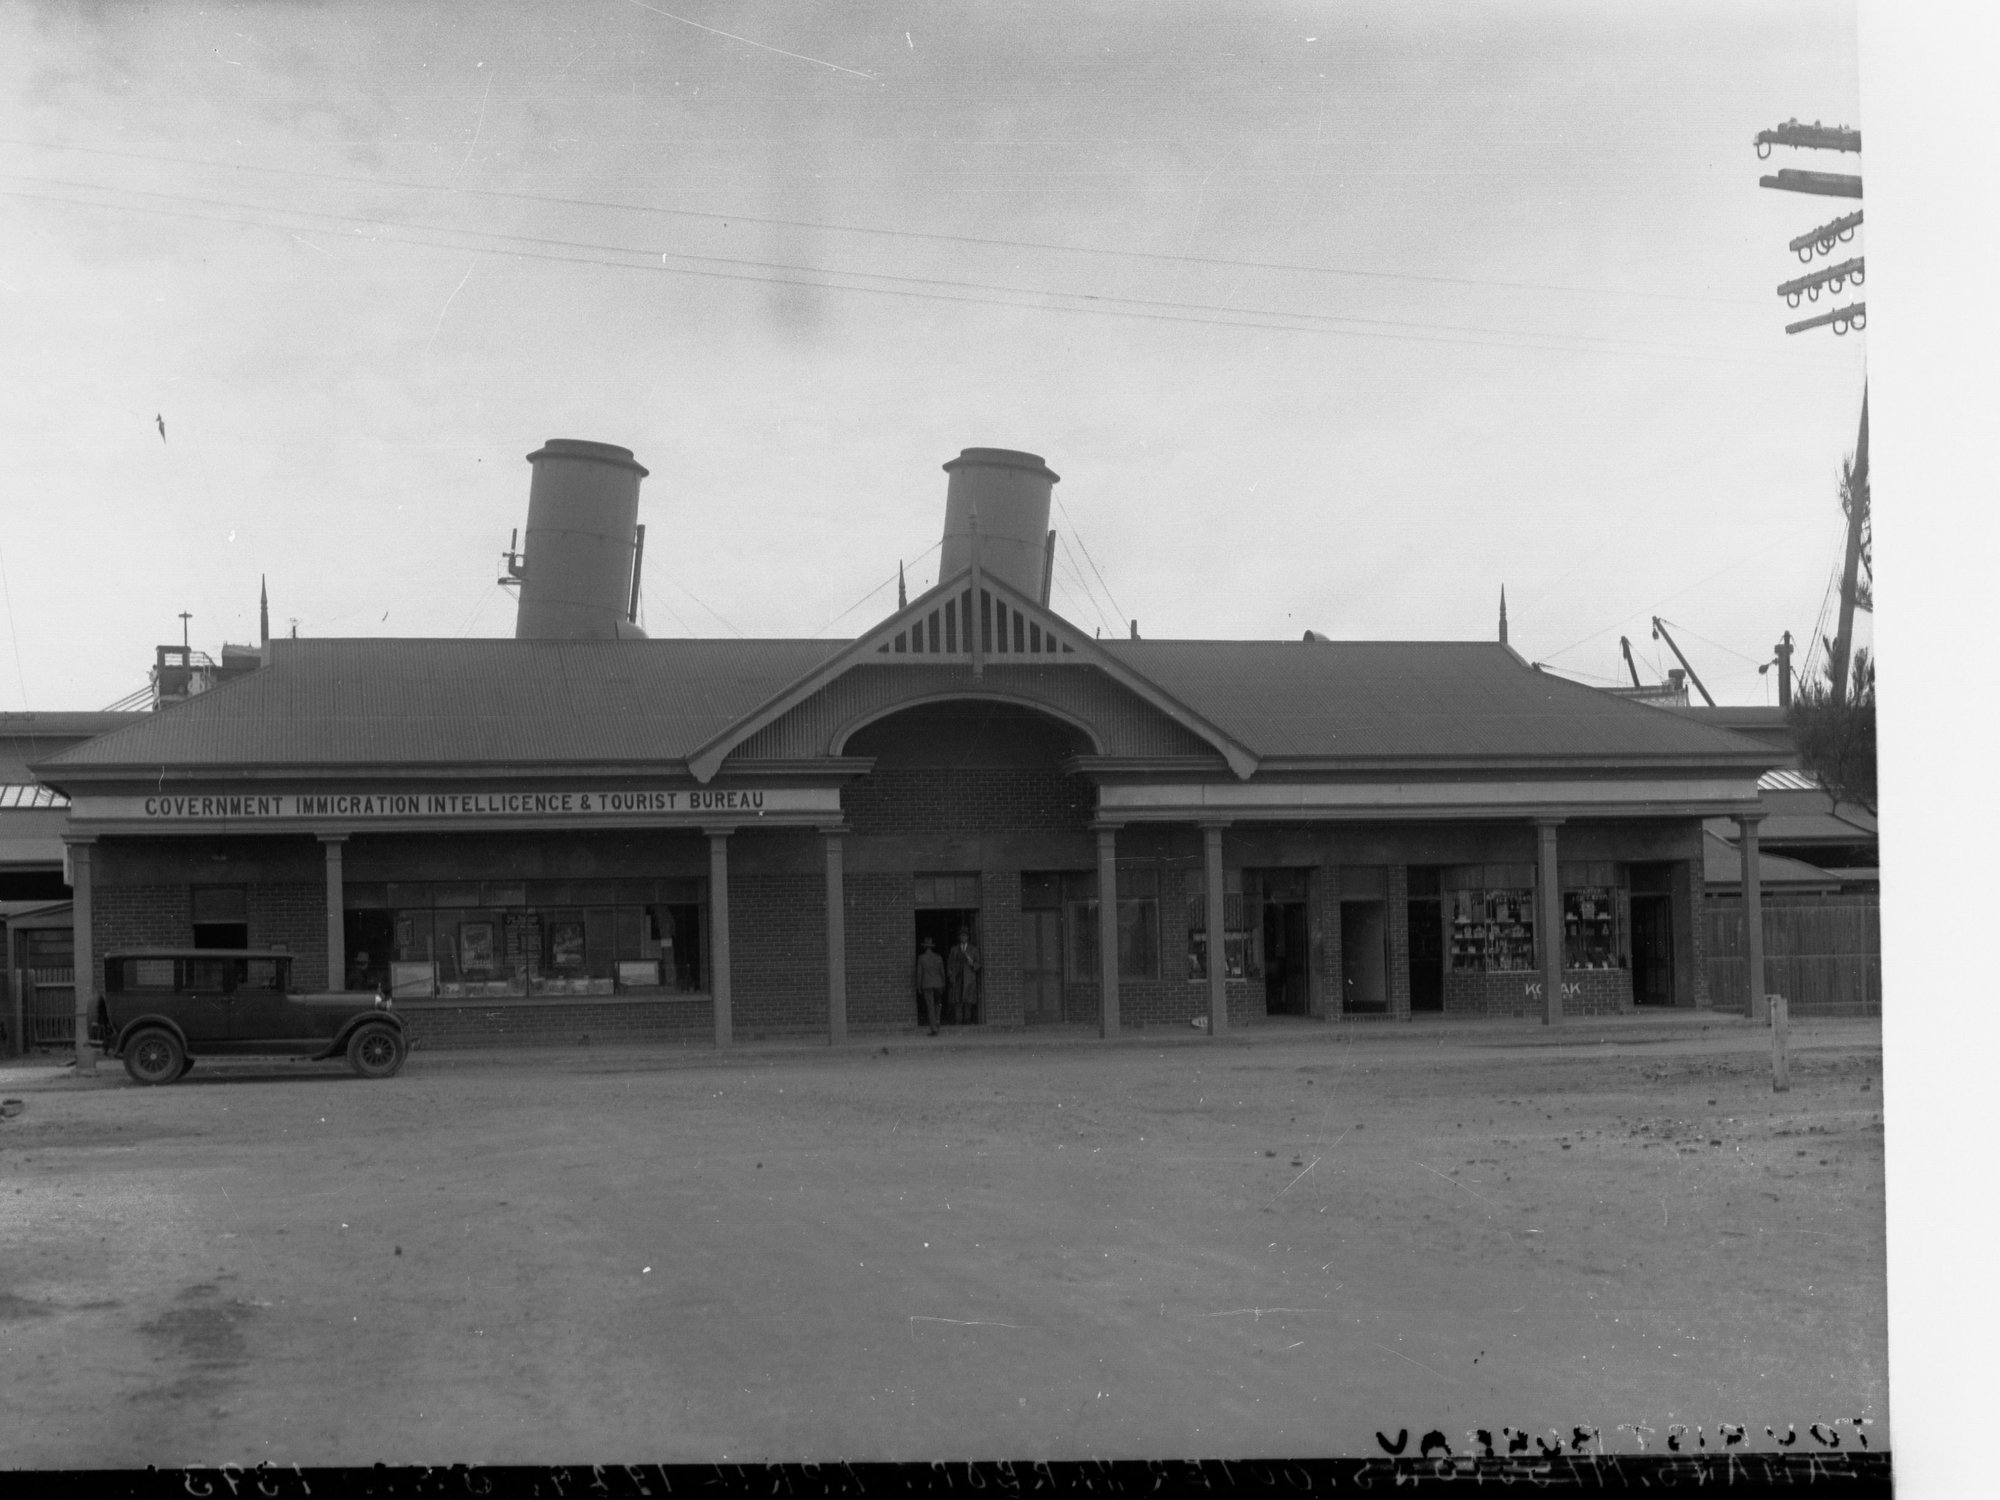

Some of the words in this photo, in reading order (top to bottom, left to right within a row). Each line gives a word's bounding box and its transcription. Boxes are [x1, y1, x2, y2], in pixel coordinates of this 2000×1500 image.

[145, 797, 283, 816] GOVERNMENT
[296, 796, 420, 815] IMMIGRATION
[428, 794, 573, 813] INTELLIGENCE
[580, 794, 592, 811] &
[598, 793, 677, 811] TOURIST
[689, 791, 764, 809] BUREAU
[1525, 983, 1581, 996] KOAK
